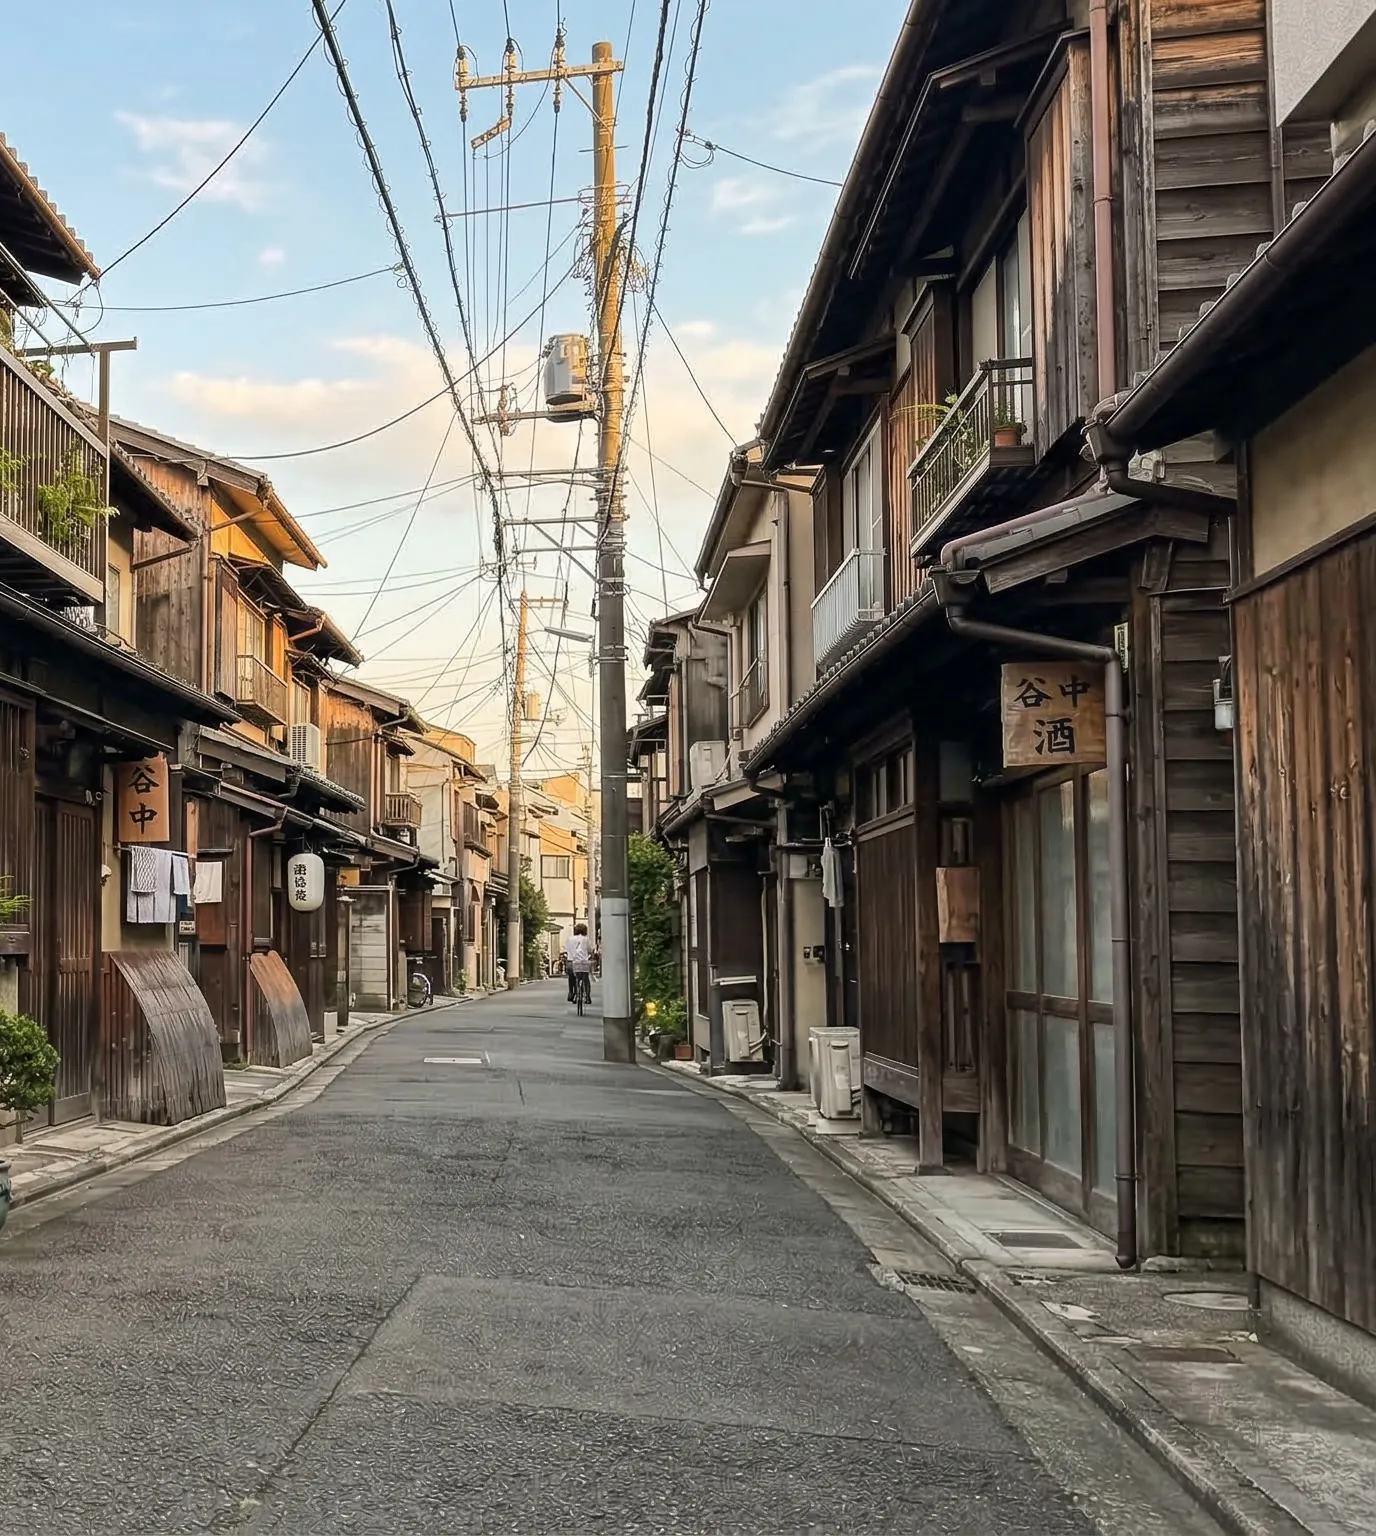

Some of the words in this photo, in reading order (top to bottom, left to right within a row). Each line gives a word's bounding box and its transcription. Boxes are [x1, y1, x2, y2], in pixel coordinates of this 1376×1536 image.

[1013, 675, 1091, 708] 谷中
[1032, 717, 1076, 756] 酒
[128, 765, 159, 834] 谷中
